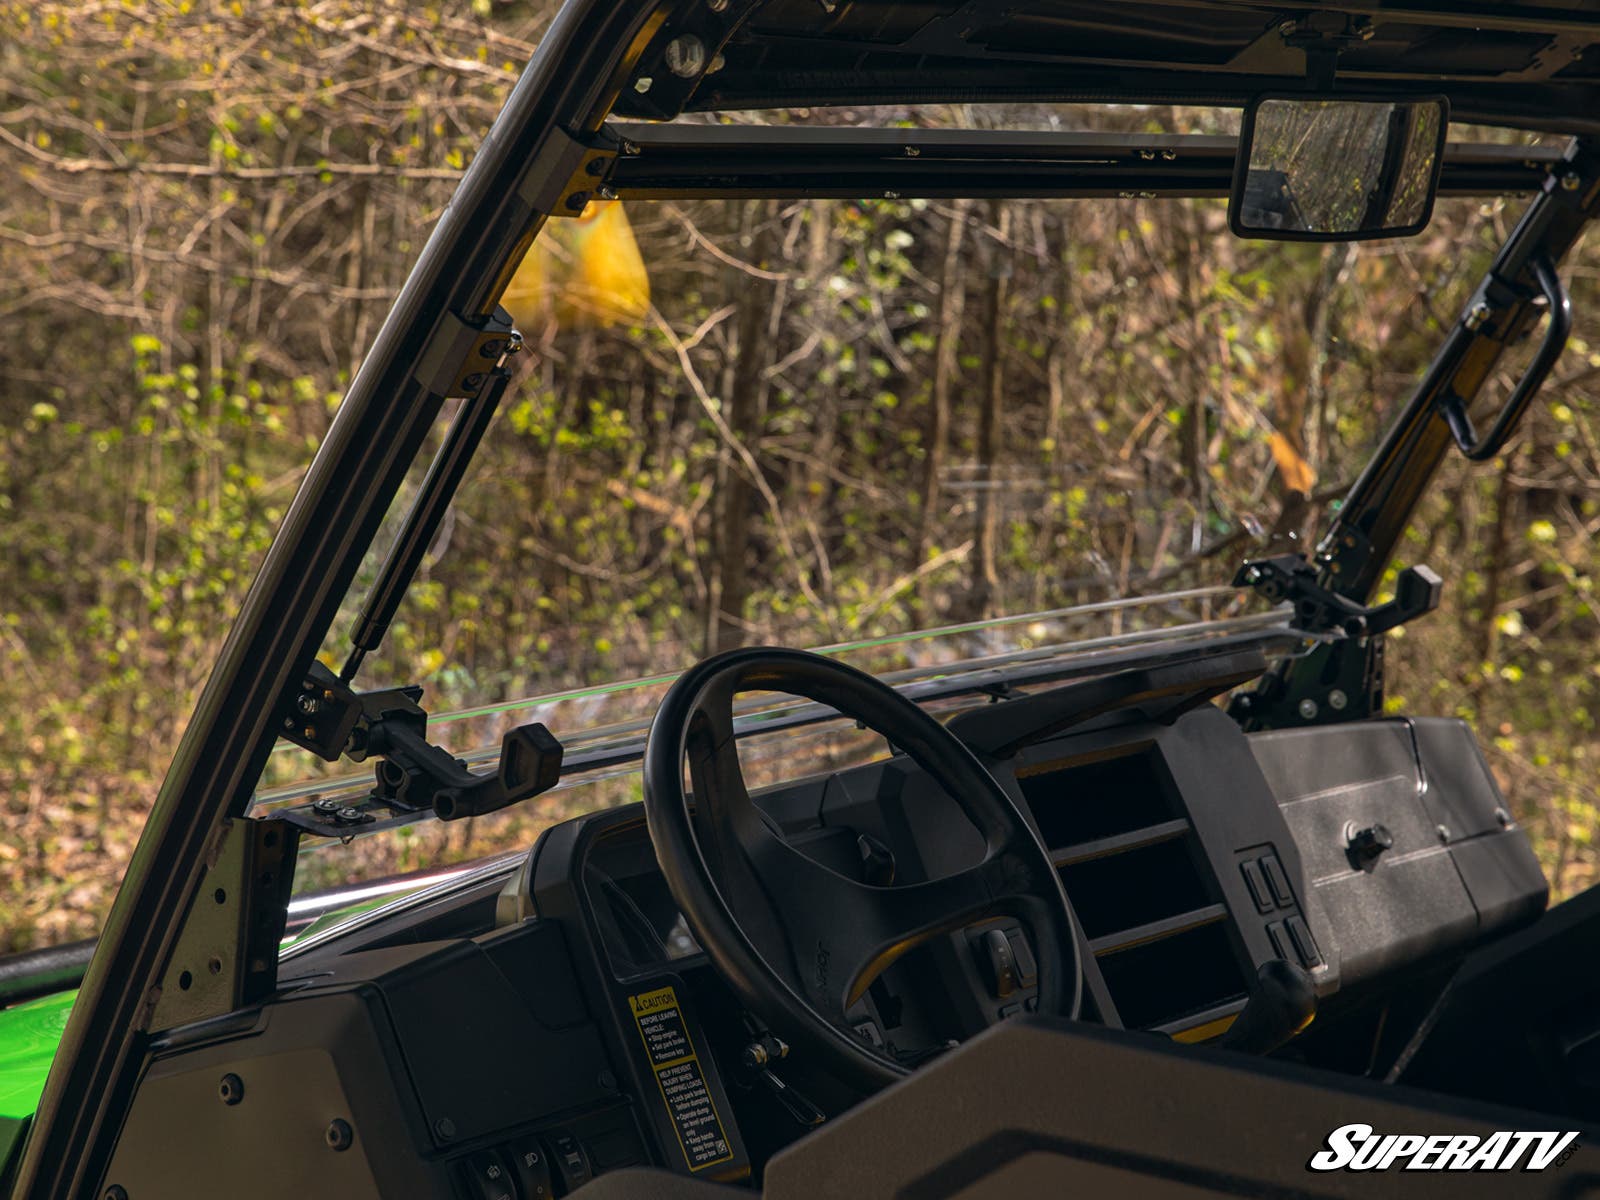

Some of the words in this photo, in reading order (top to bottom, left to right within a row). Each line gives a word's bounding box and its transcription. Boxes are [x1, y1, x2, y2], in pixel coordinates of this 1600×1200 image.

[642, 993, 674, 1008] CAUTION
[640, 1015, 659, 1025] BEFORE
[658, 1010, 677, 1020] LEAVING
[658, 1051, 676, 1060] Remove
